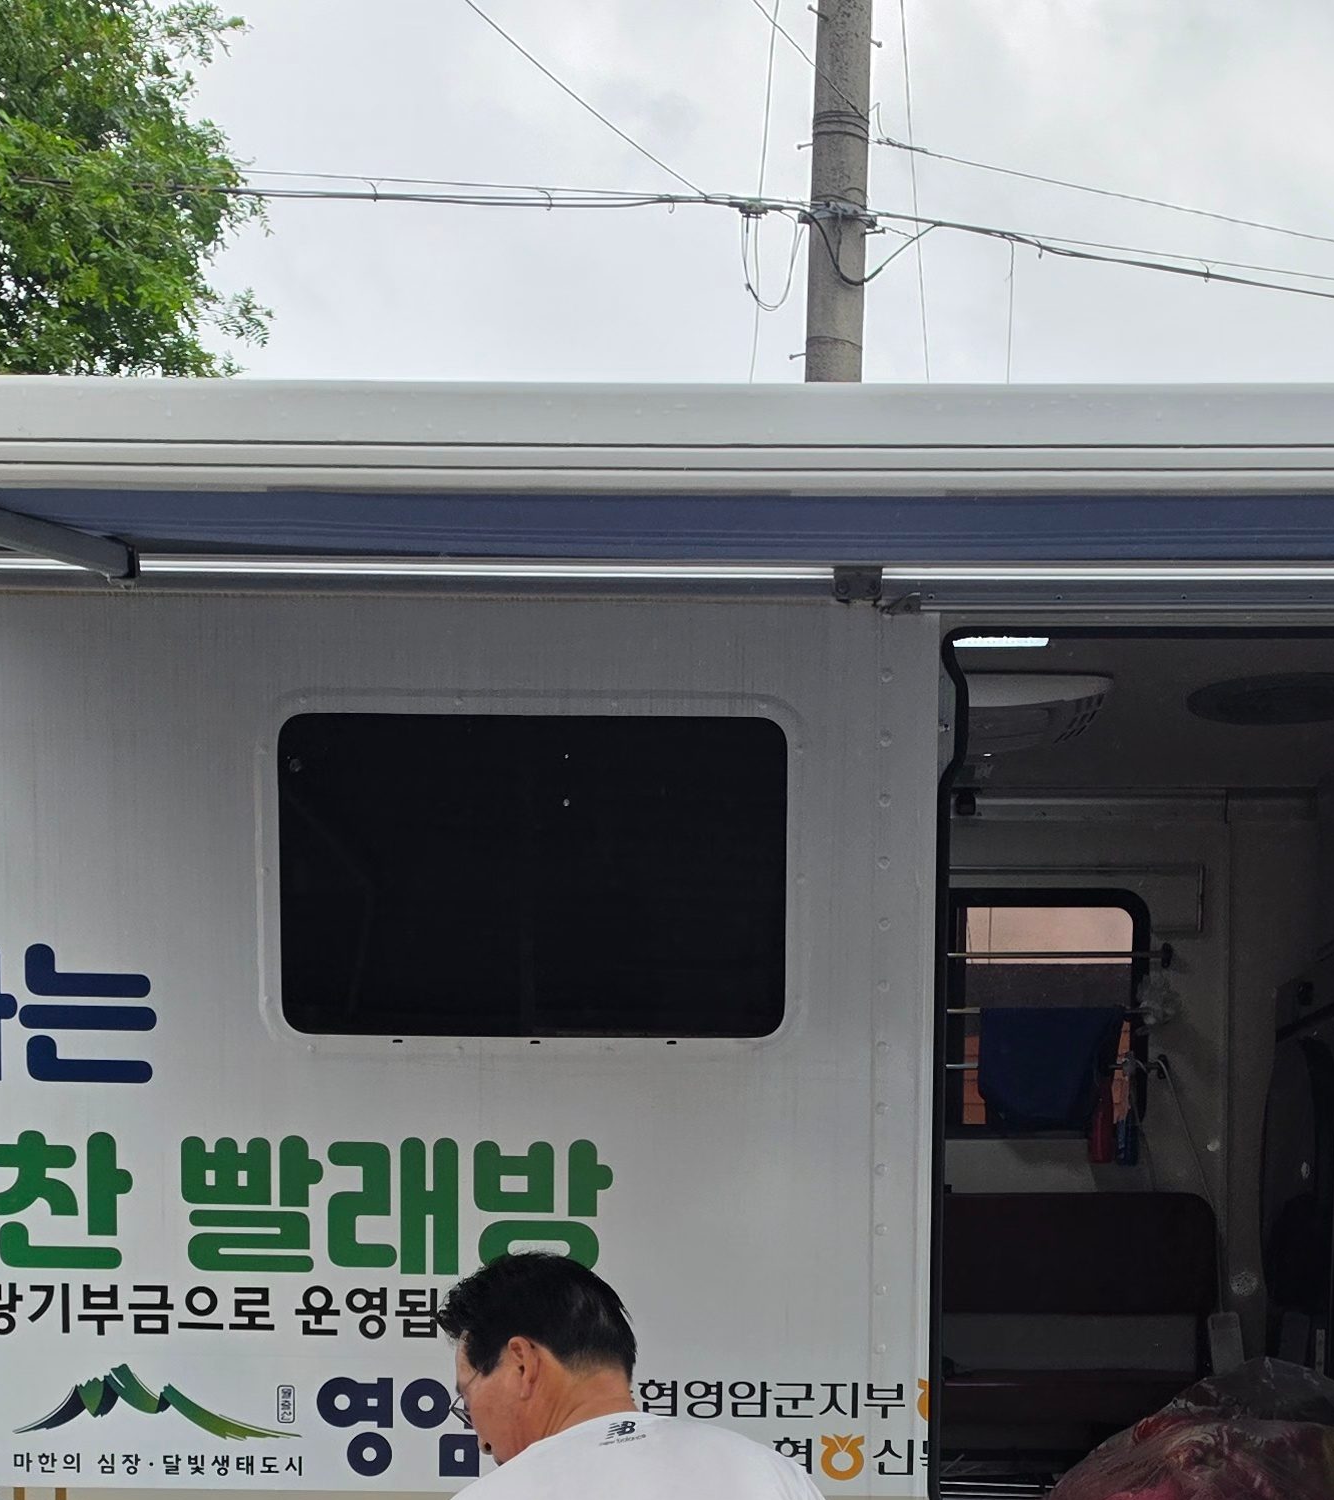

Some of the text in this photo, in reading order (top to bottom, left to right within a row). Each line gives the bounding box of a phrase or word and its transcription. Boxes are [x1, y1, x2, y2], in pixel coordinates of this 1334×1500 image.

[180, 1134, 614, 1275] 빨래방
[631, 1379, 906, 1419] 협영암군지부
[13, 1452, 81, 1474] 마한의
[872, 1439, 928, 1476] 신
